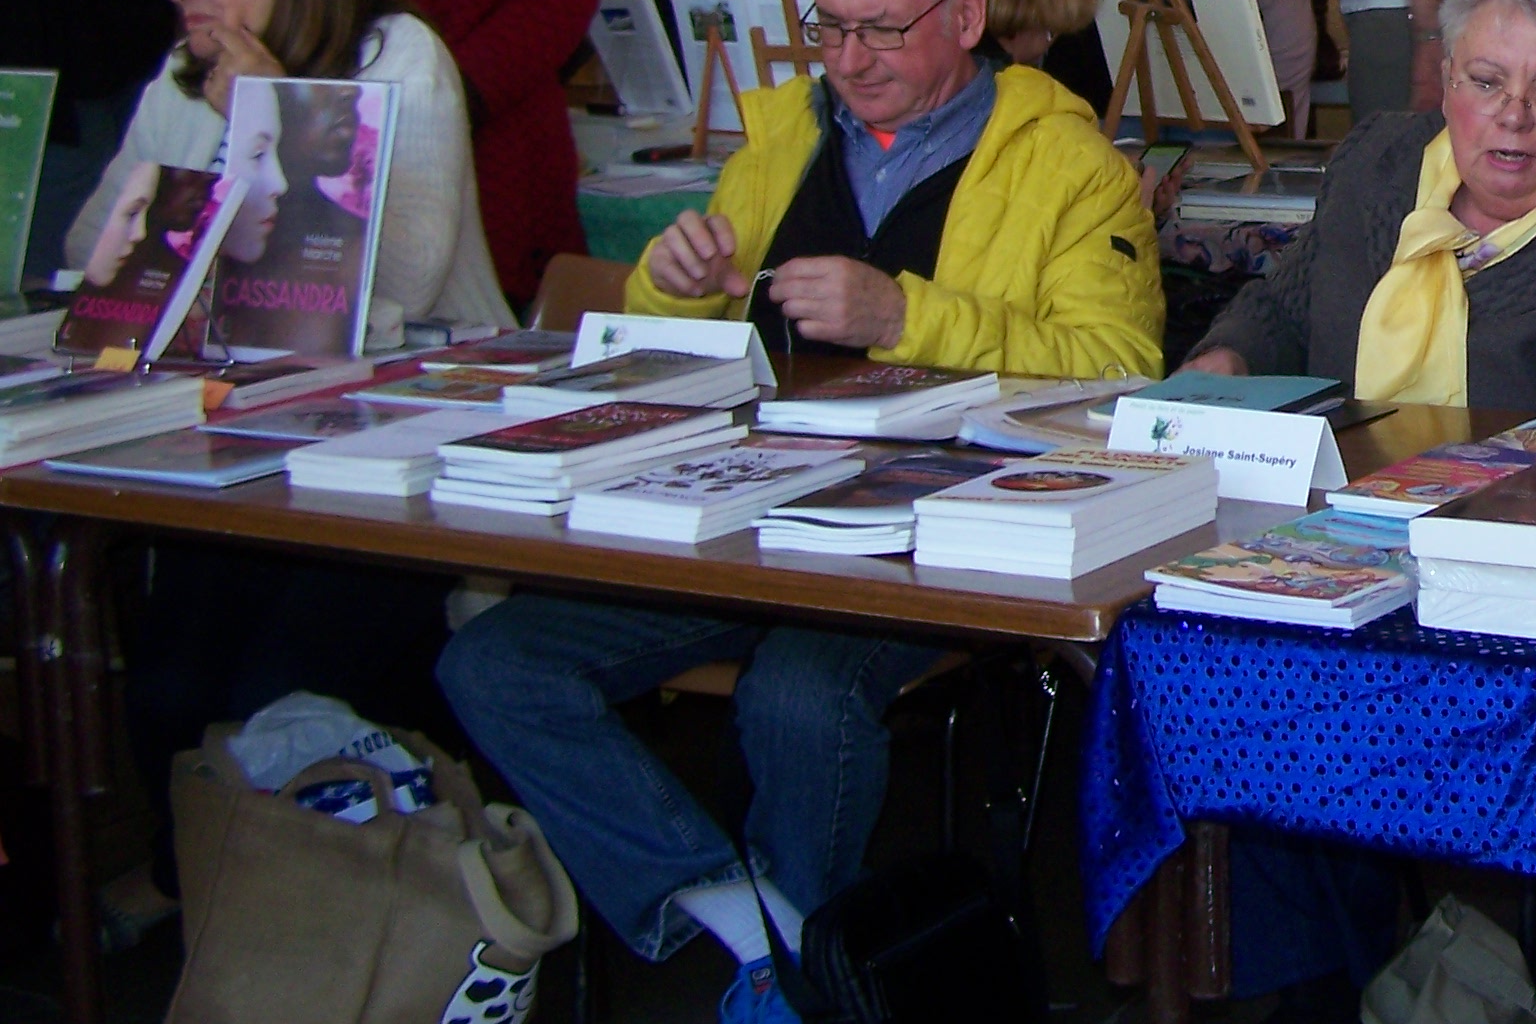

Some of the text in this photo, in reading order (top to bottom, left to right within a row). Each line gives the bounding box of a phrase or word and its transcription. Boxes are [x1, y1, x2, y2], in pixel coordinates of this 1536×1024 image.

[222, 277, 349, 315] CASSANDRA
[1182, 445, 1225, 459] Josiane
[1227, 450, 1297, 468] Saint-Supéry
